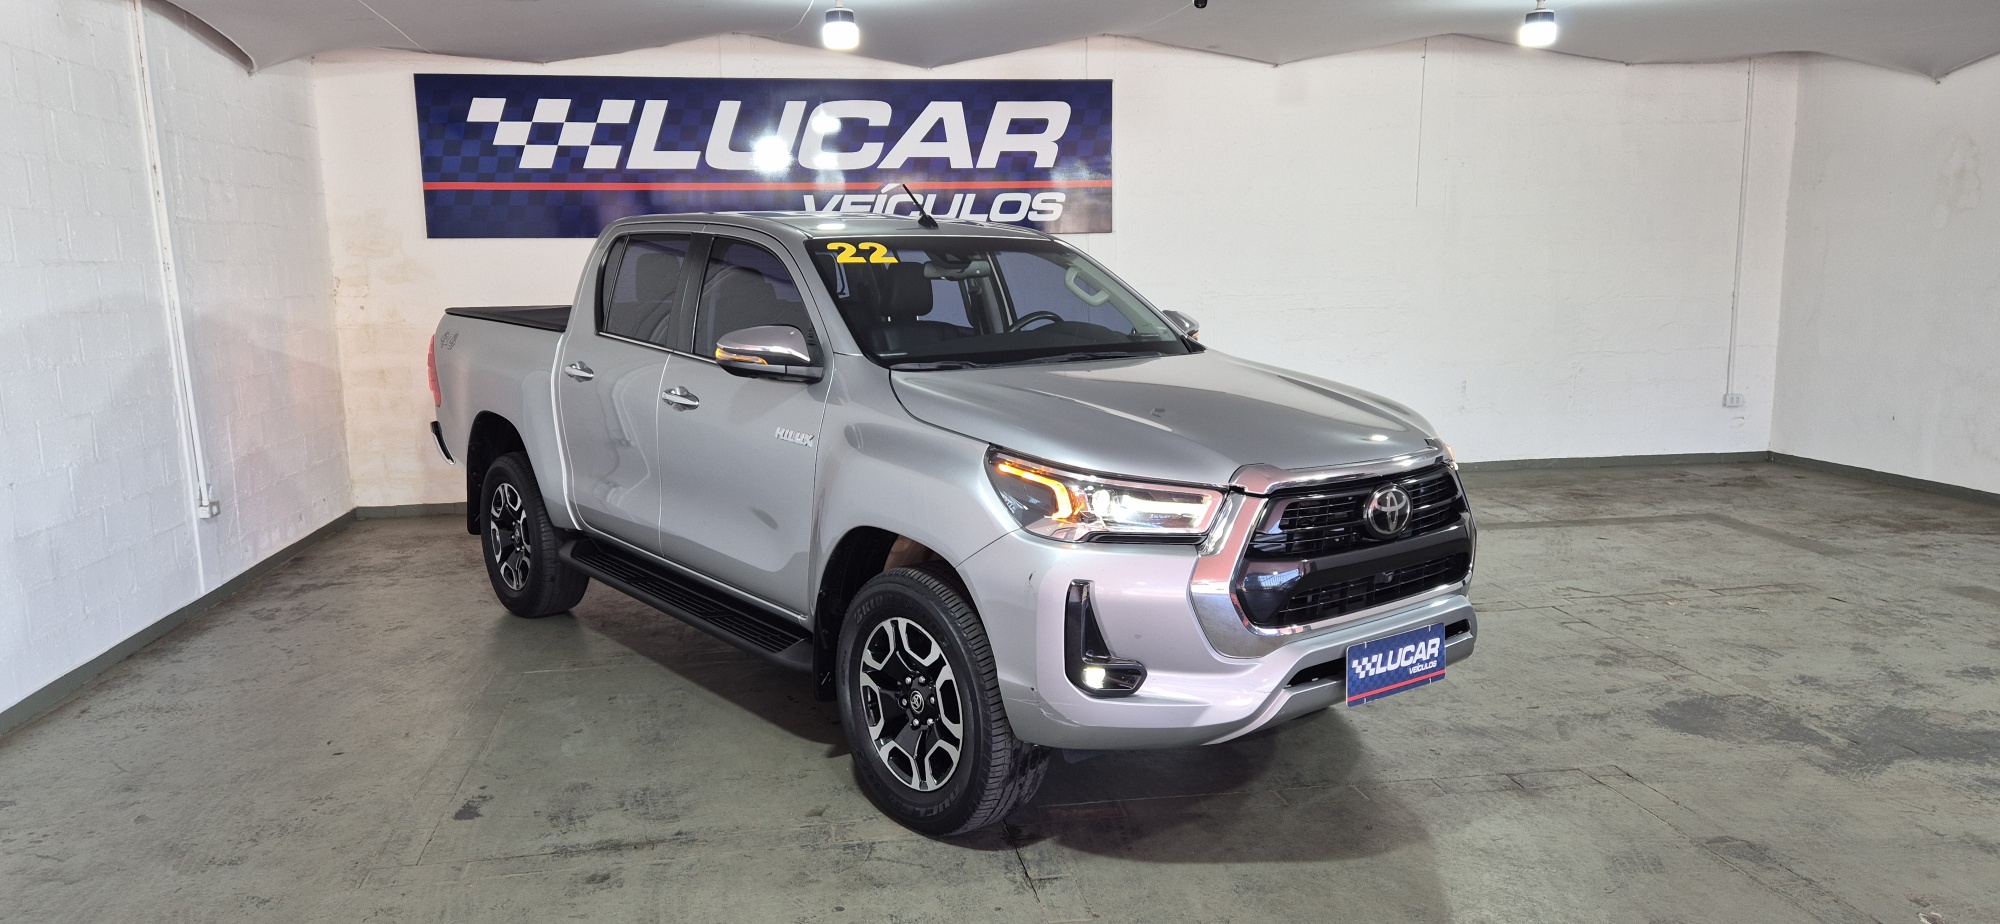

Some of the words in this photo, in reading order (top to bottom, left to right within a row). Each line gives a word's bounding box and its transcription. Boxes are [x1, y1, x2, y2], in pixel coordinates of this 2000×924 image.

[624, 99, 1071, 170] LUCAR
[803, 183, 1066, 222] VEÍCULOS
[827, 242, 898, 263] 22
[775, 426, 814, 447] HILUX
[1375, 637, 1440, 675] LUCAR
